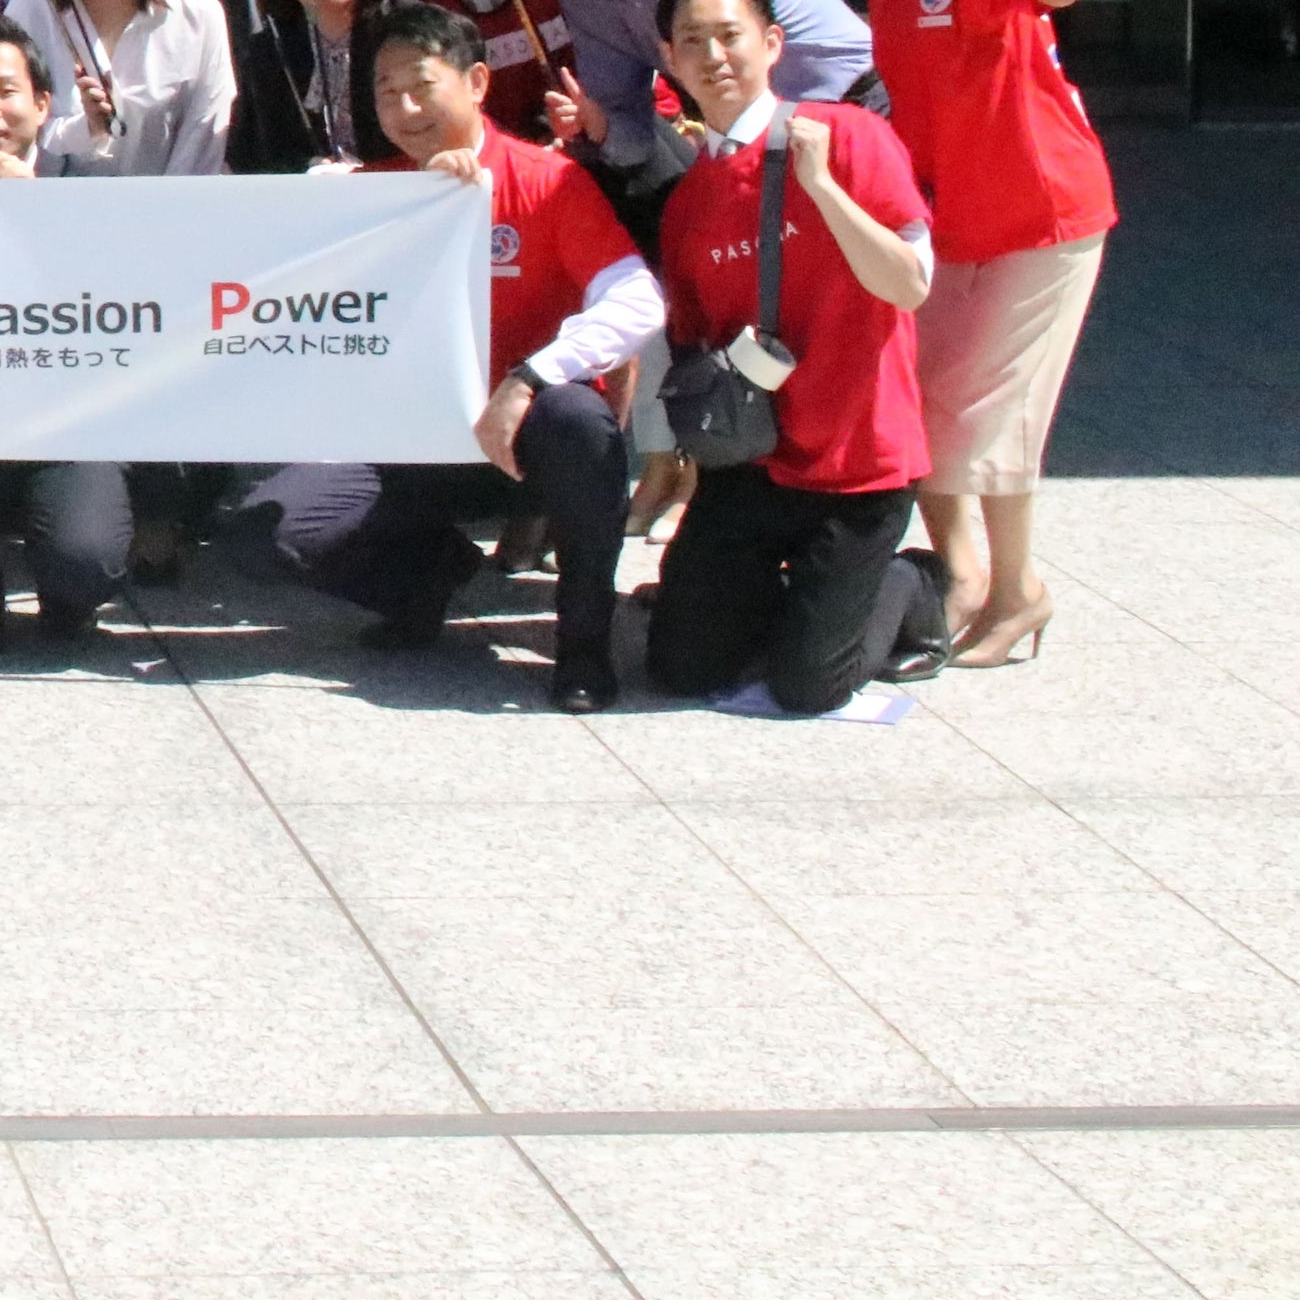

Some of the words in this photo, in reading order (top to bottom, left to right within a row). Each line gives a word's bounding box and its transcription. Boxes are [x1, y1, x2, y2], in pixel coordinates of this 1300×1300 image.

[710, 221, 799, 265] PASA
[210, 281, 389, 331] Power
[203, 334, 391, 357] 自己ベストに挑む
